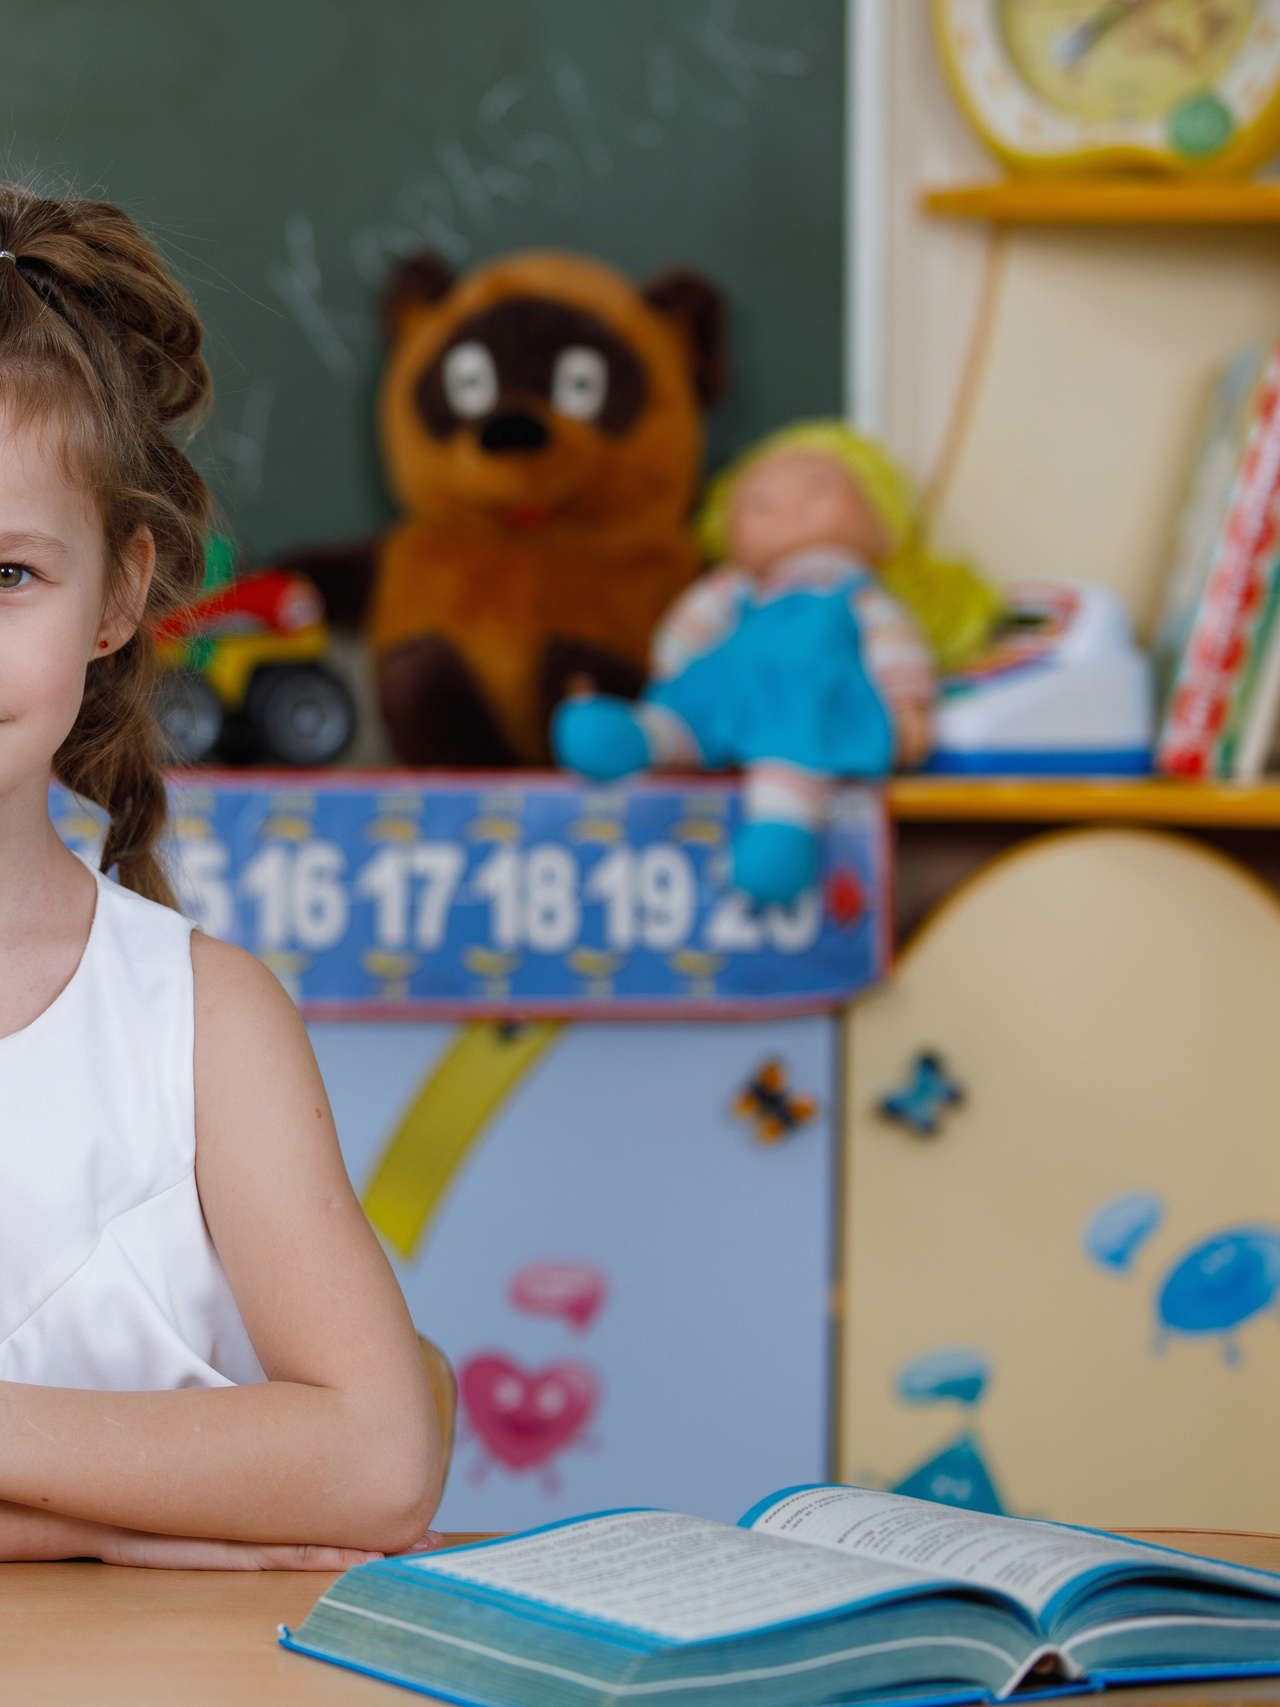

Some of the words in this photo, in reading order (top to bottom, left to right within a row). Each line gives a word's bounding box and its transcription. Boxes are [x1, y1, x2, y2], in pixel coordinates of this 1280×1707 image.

[238, 840, 350, 949] 16
[357, 841, 466, 953] 17
[474, 843, 581, 953] 18
[584, 843, 695, 951] 19
